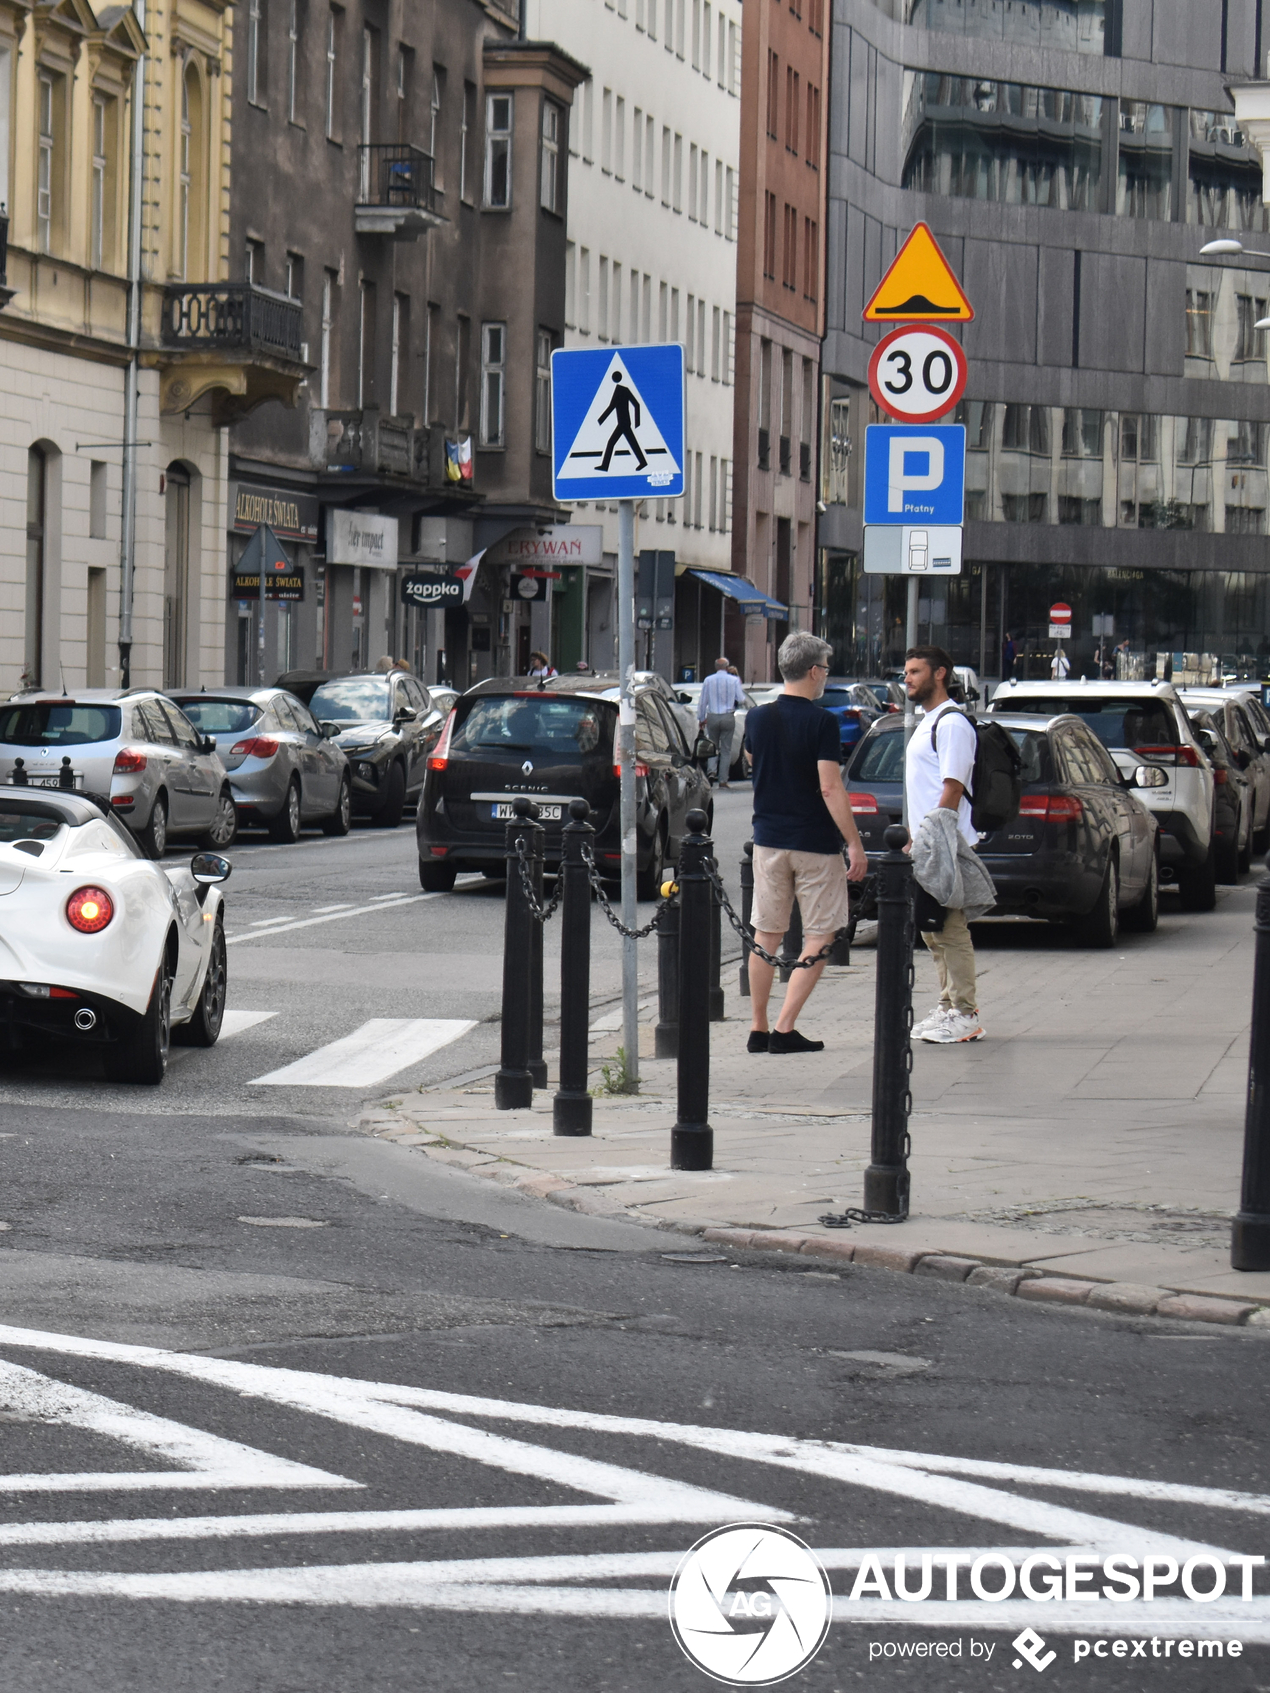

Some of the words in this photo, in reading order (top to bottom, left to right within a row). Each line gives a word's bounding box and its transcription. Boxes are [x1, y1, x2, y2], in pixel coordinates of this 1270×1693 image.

[884, 350, 952, 394] 30
[888, 437, 944, 512] P
[235, 492, 273, 525] ALKOHOLE
[273, 494, 300, 529] ŚWIATA
[904, 503, 934, 515] Płatny
[508, 539, 581, 555] ERYWAŃ
[236, 577, 273, 587] ALKOHLE
[275, 575, 302, 588] ŚWIATA
[406, 581, 459, 597] żappka
[684, 670, 691, 678] P
[504, 784, 549, 792] SCENIC
